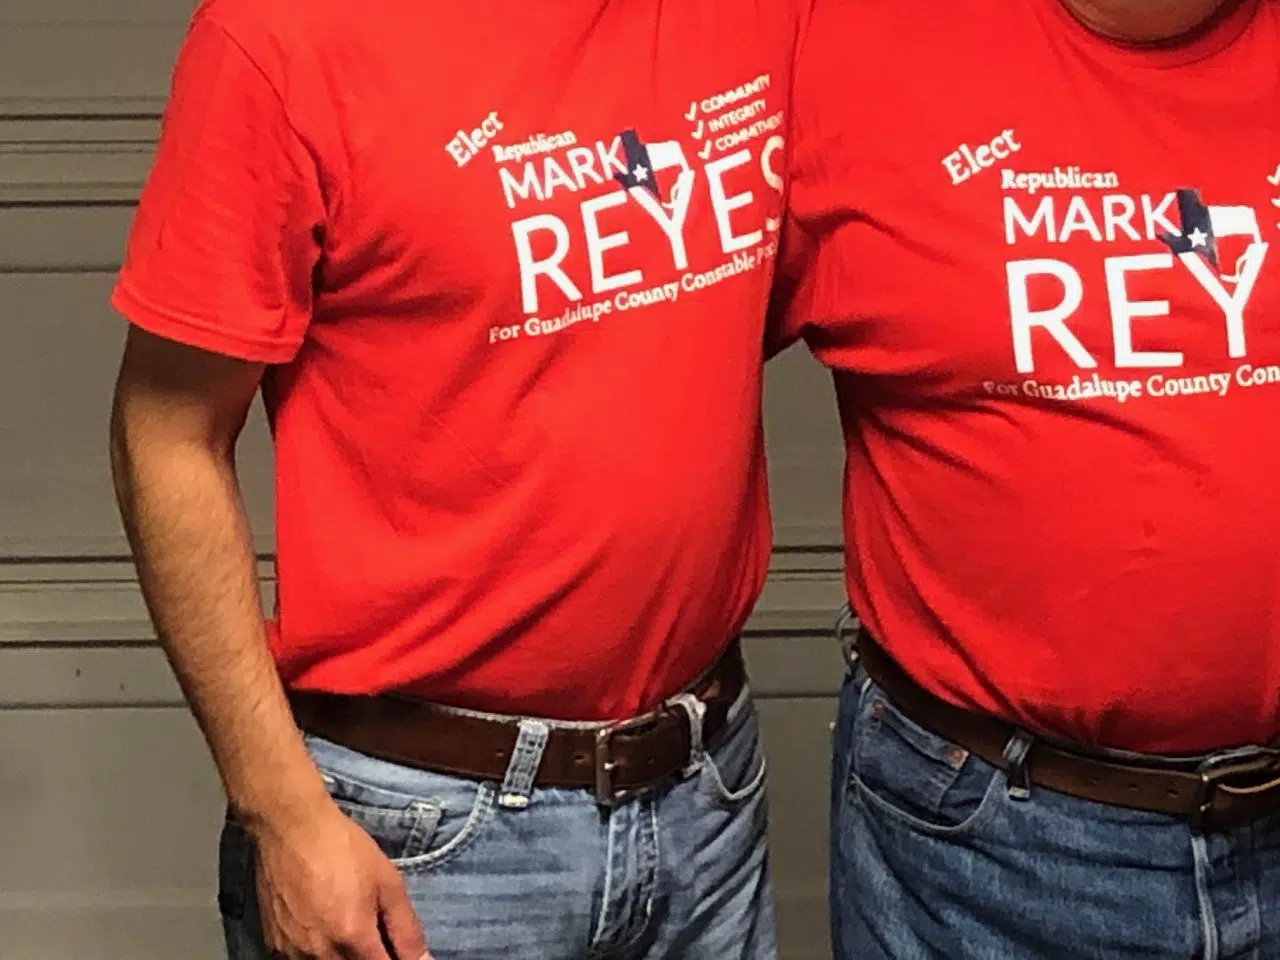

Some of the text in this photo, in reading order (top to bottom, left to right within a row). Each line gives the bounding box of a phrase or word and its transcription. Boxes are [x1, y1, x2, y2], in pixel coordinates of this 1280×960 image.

[700, 73, 770, 113] COMMUNITY
[708, 98, 766, 132] INTEGRITY
[445, 111, 504, 167] Elect
[492, 129, 576, 163] Republican
[942, 128, 1021, 185] Elect
[498, 135, 628, 208] MARK
[1000, 166, 1118, 192] Republican
[1003, 193, 1183, 245] MARK
[489, 325, 520, 343] For
[524, 301, 612, 334] Guadalupe
[614, 283, 679, 311] County
[681, 250, 756, 291] Constable
[983, 380, 1019, 396] For
[1022, 373, 1143, 403] Guadalupe
[1146, 370, 1231, 397] County
